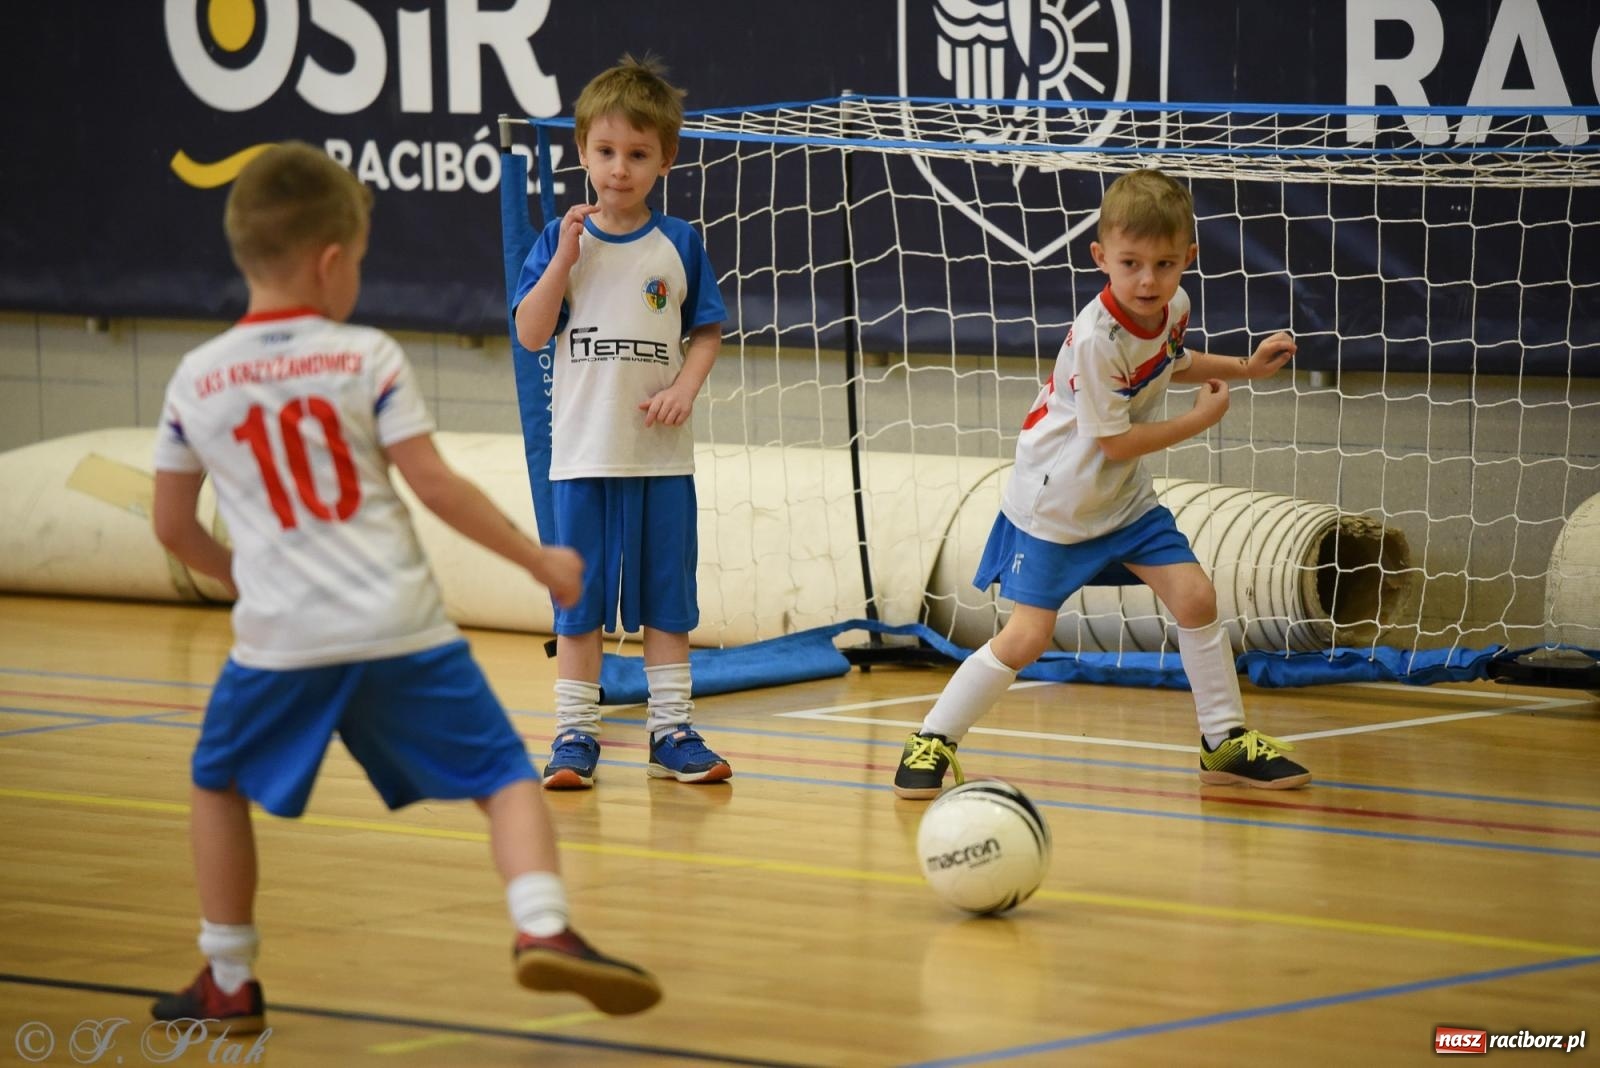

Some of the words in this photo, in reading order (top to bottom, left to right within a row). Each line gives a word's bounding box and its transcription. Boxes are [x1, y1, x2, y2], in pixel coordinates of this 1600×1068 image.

[1347, 0, 1600, 146] RA
[232, 395, 362, 531] 10
[926, 837, 1001, 873] macron
